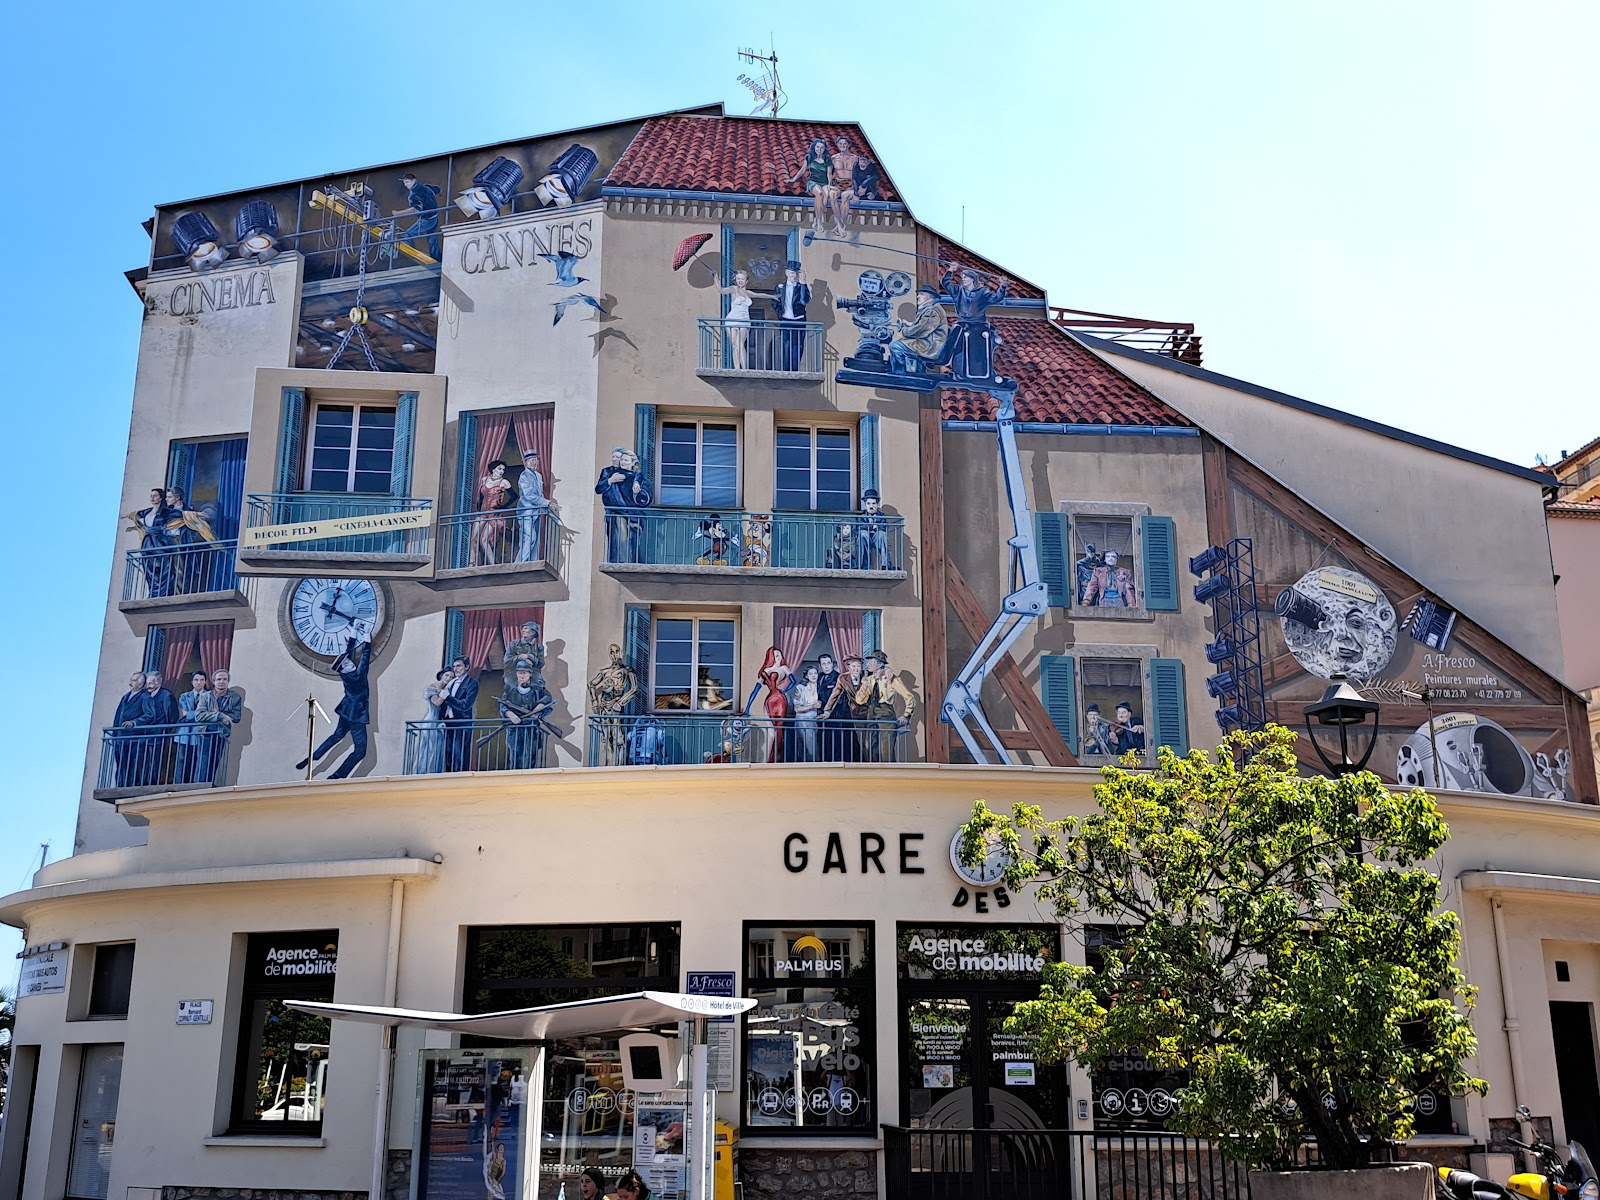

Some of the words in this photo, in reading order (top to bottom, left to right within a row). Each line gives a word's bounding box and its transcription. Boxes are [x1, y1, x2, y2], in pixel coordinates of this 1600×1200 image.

[461, 219, 592, 274] CANNES
[170, 269, 276, 316] CINEMA
[292, 526, 318, 536] FILM
[1422, 653, 1475, 673] A.Fresco
[1425, 673, 1462, 685] Peintures
[1466, 674, 1497, 686] murales
[784, 832, 925, 874] GARE
[952, 886, 1011, 914] DES
[265, 947, 318, 963] Agence
[908, 935, 985, 955] Agence
[264, 962, 281, 976] de
[776, 960, 813, 971] PALM
[815, 960, 842, 971] BUS
[932, 951, 957, 971] de
[960, 953, 1045, 972] mobilité
[709, 1001, 725, 1010] Hôtel
[725, 1002, 732, 1010] de
[733, 1002, 744, 1010] Ville
[802, 1021, 860, 1048] Bus
[912, 1022, 967, 1033] Bienvenue
